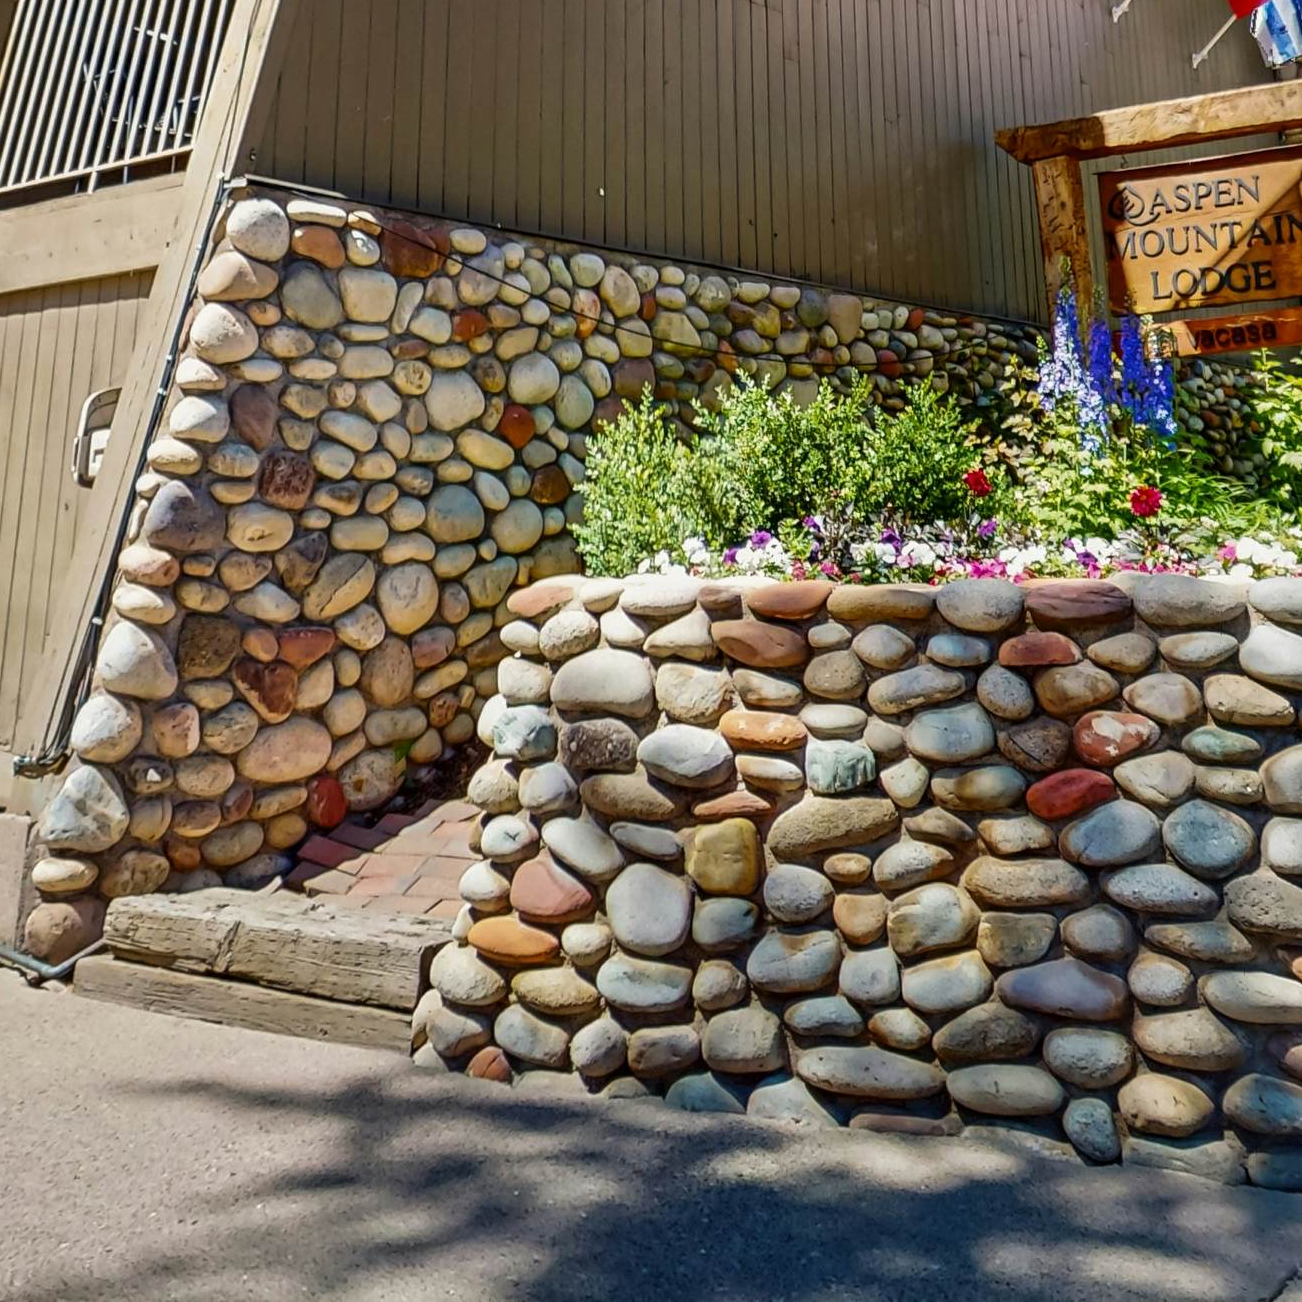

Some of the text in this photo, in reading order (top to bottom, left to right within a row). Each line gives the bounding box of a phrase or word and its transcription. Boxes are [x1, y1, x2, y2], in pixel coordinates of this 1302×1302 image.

[1148, 175, 1261, 216] ASPEN
[1150, 260, 1277, 300] LODGE
[1186, 321, 1278, 349] vacasa
